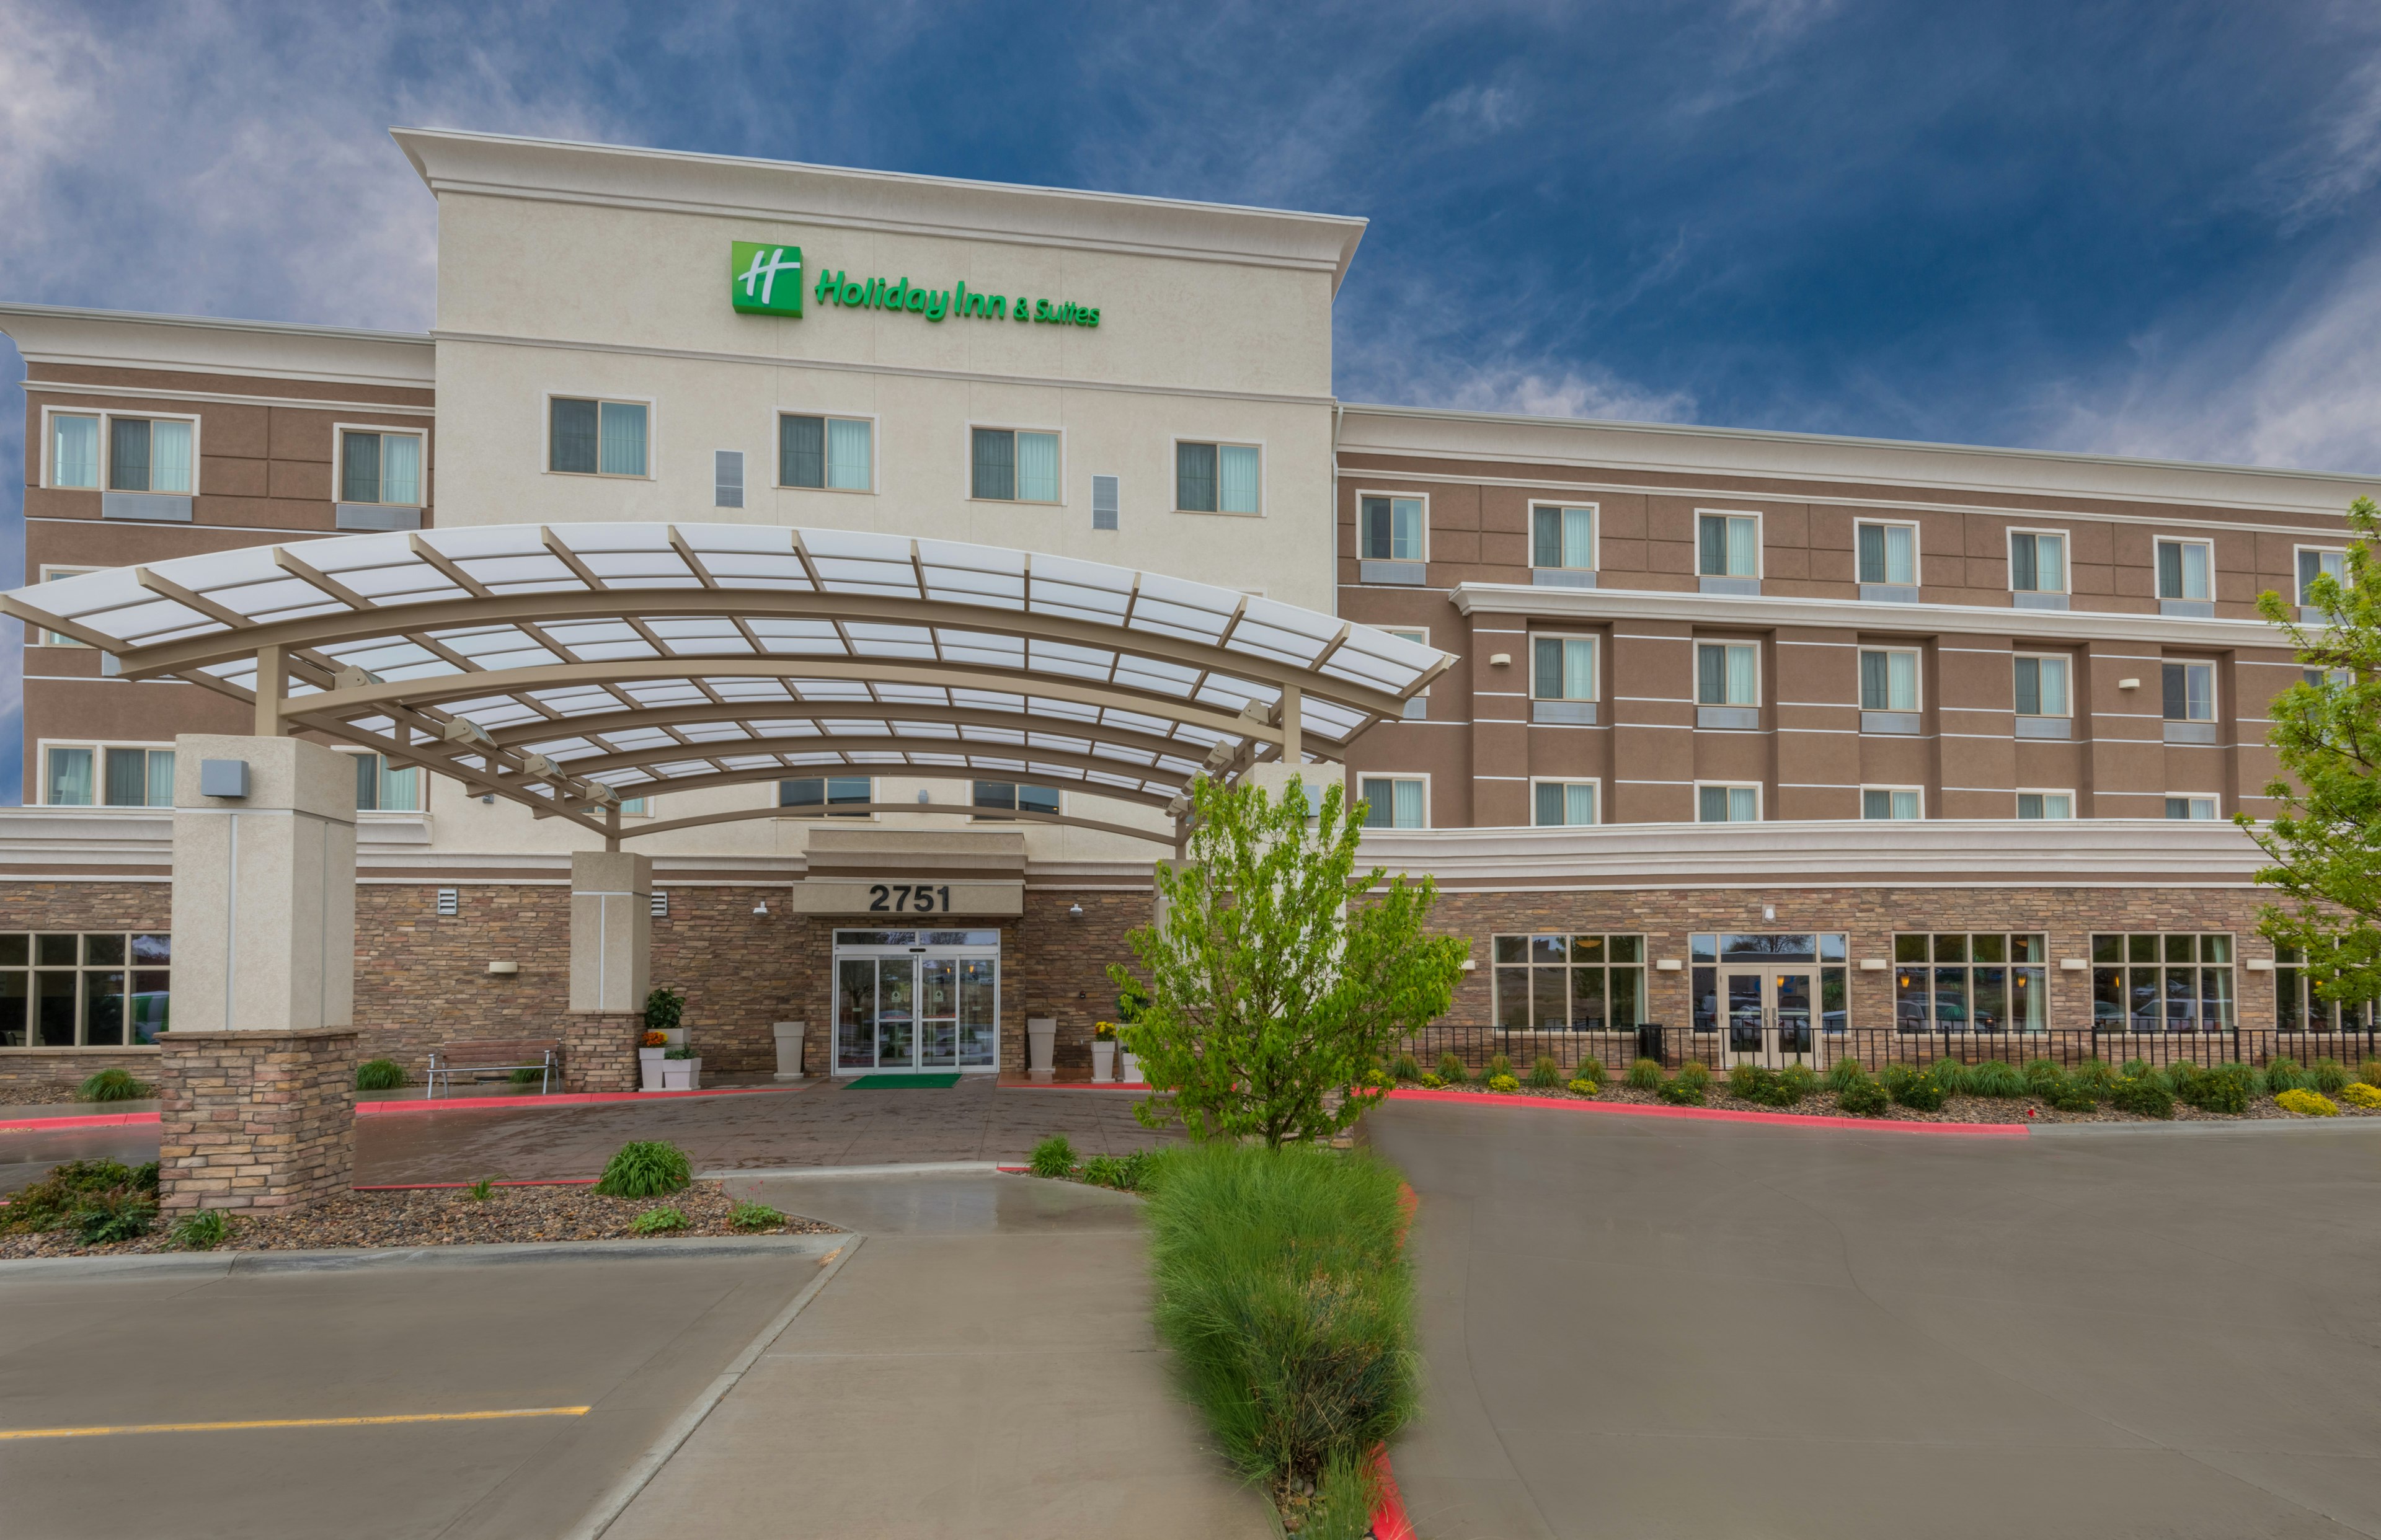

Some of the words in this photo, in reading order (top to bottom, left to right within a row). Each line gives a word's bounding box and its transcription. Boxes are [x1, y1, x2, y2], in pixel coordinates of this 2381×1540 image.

[814, 269, 949, 322] Holiday
[954, 281, 1006, 320] Inn
[1013, 297, 1029, 322] &
[1034, 299, 1101, 327] Suites
[869, 885, 949, 912] 2751
